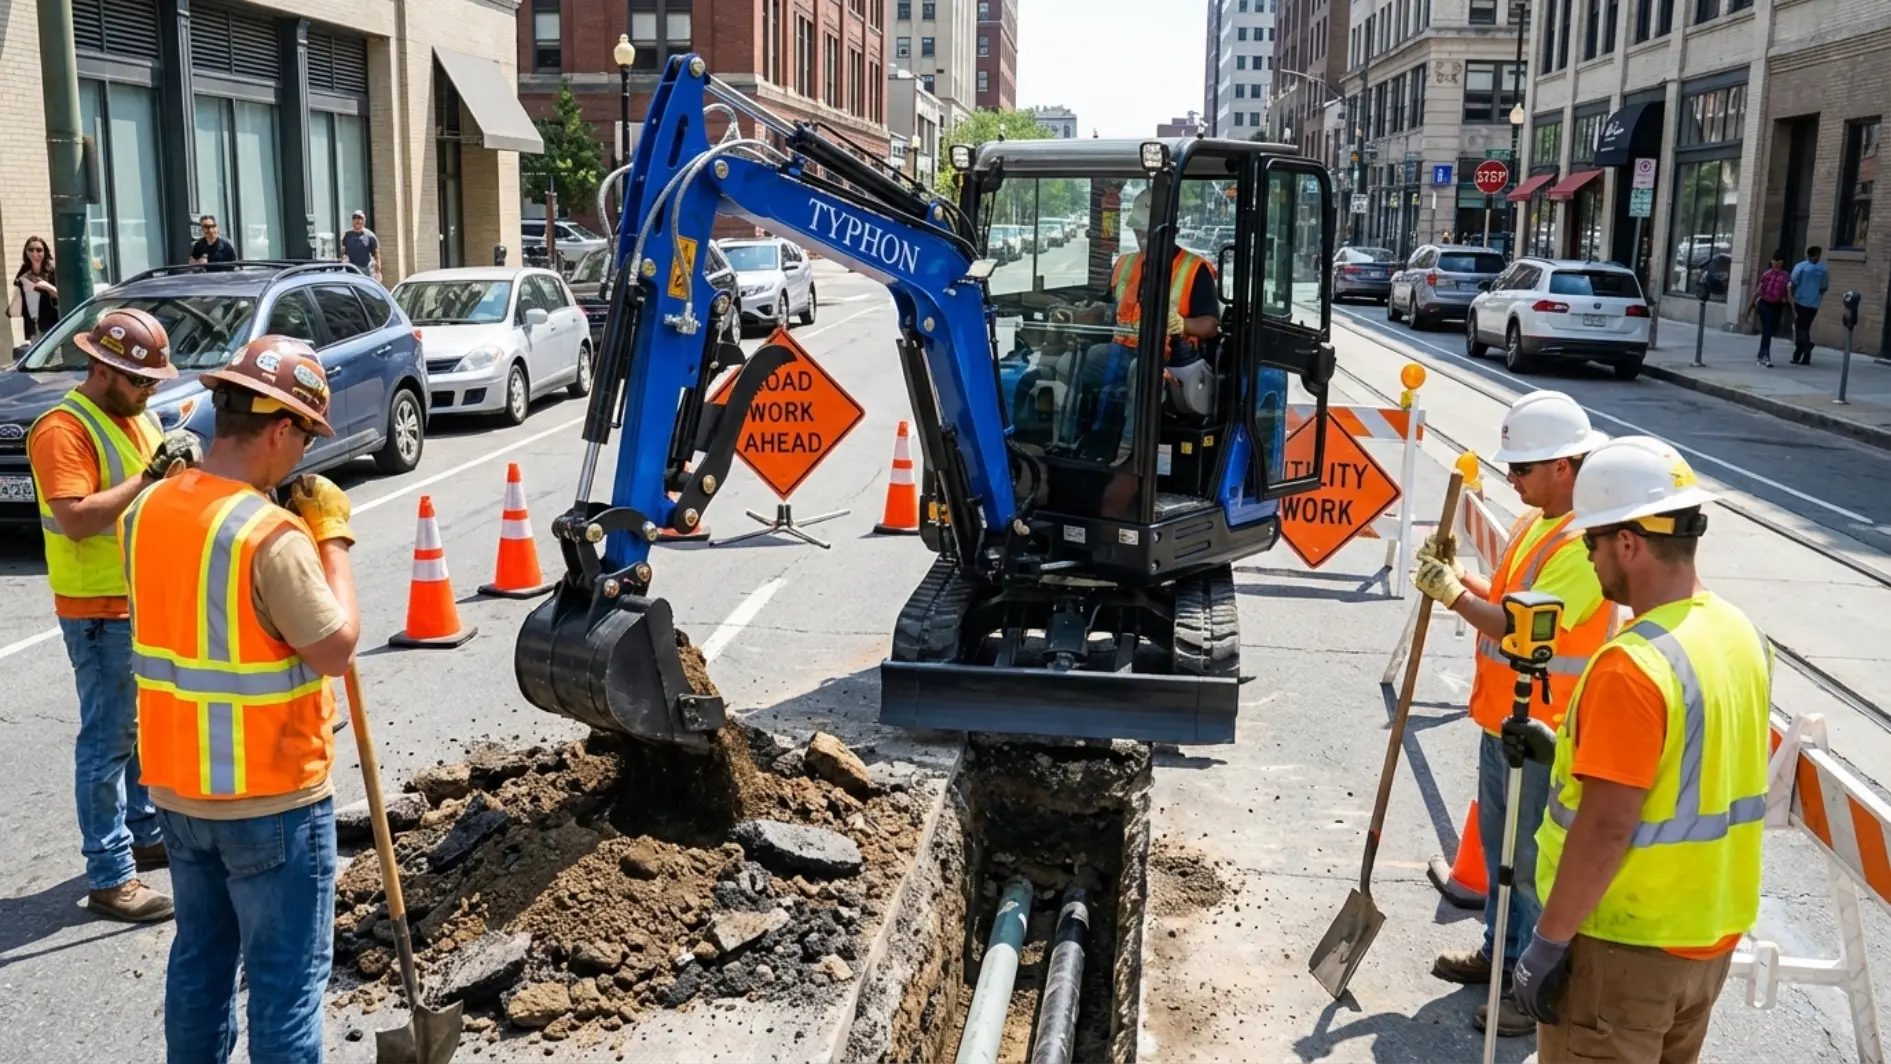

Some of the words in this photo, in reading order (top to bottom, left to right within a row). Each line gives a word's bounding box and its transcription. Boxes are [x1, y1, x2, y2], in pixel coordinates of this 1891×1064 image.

[808, 197, 921, 275] TYPHON
[759, 370, 813, 392] OAD
[750, 401, 814, 423] WORK
[744, 431, 822, 453] AHEAD
[1281, 497, 1354, 526] WORK
